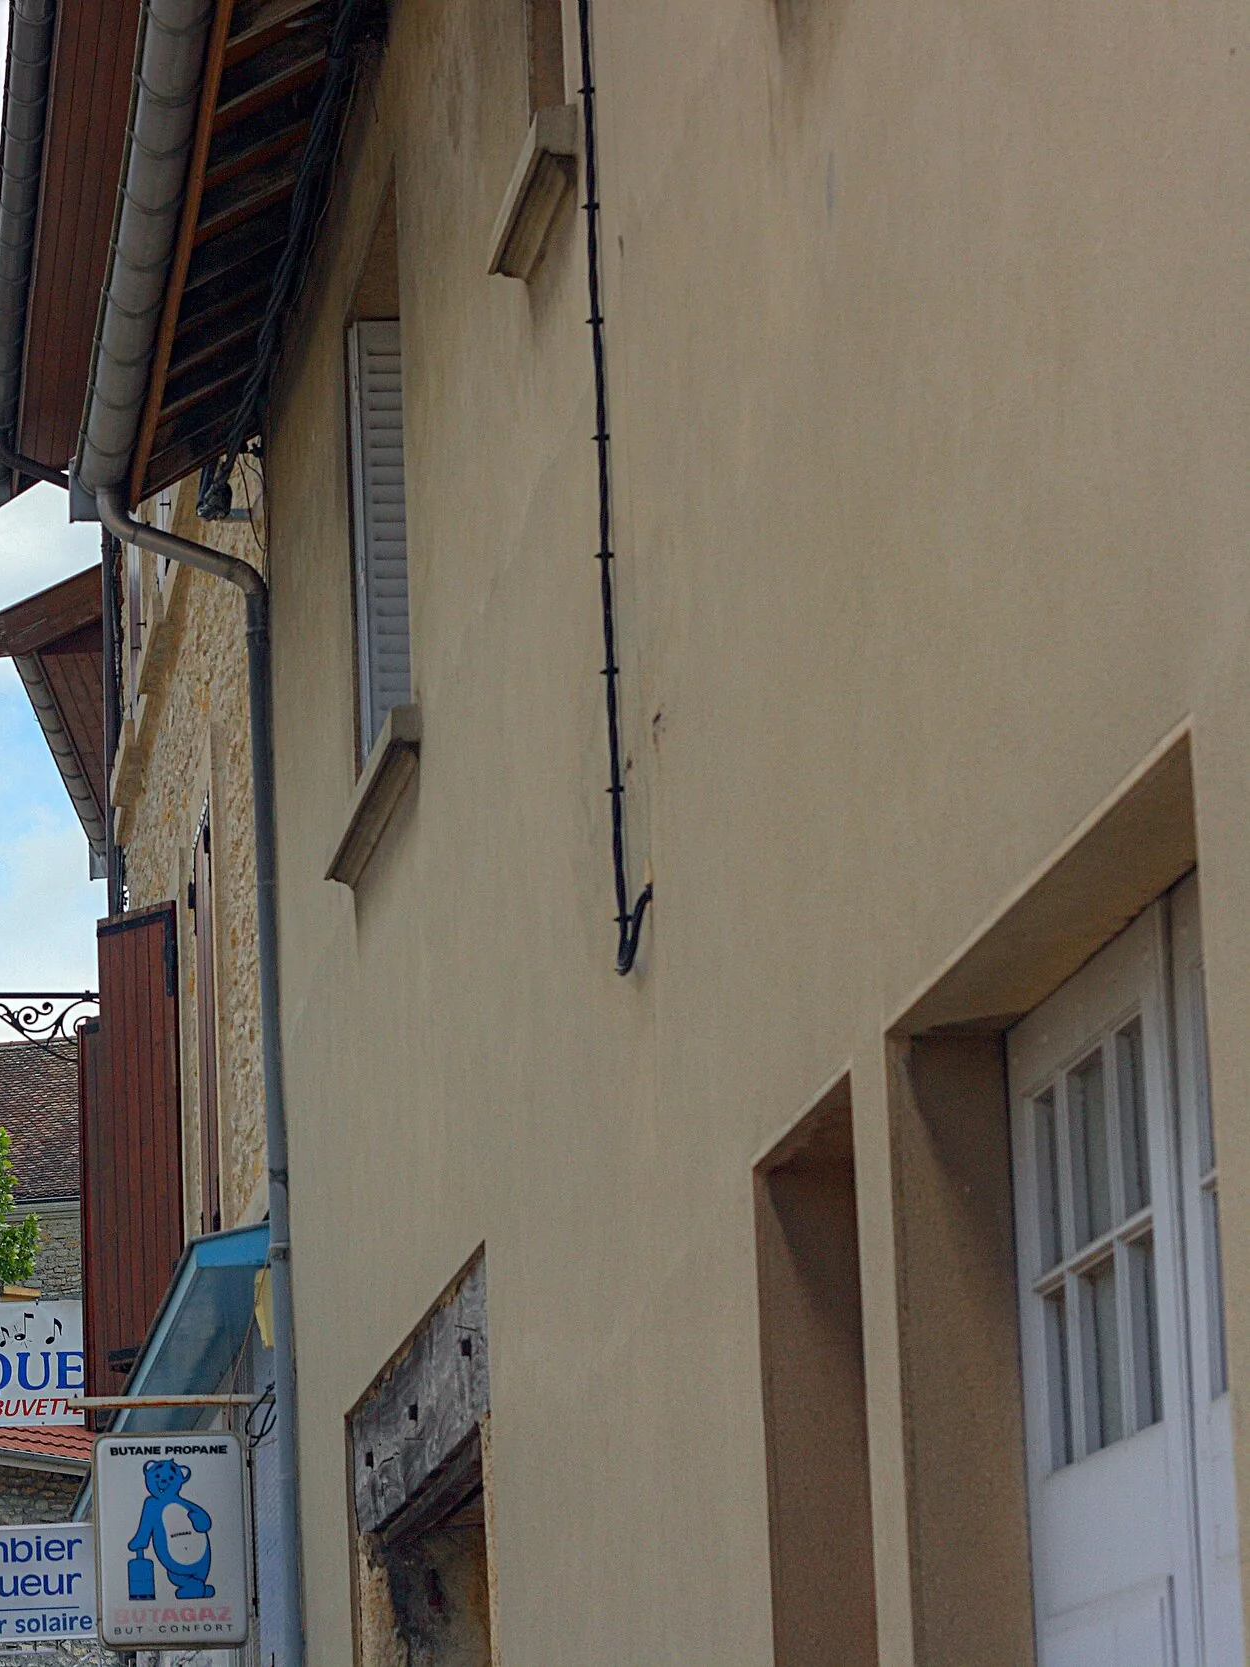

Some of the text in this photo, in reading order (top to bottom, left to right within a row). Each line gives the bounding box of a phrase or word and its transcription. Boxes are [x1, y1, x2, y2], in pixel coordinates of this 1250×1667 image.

[110, 1444, 228, 1456] BUTANE PROPANE
[114, 1606, 233, 1624] BUTAGAZ
[15, 1613, 93, 1634] solaire
[114, 1626, 143, 1635] BUT
[158, 1623, 234, 1634] CONFORT
